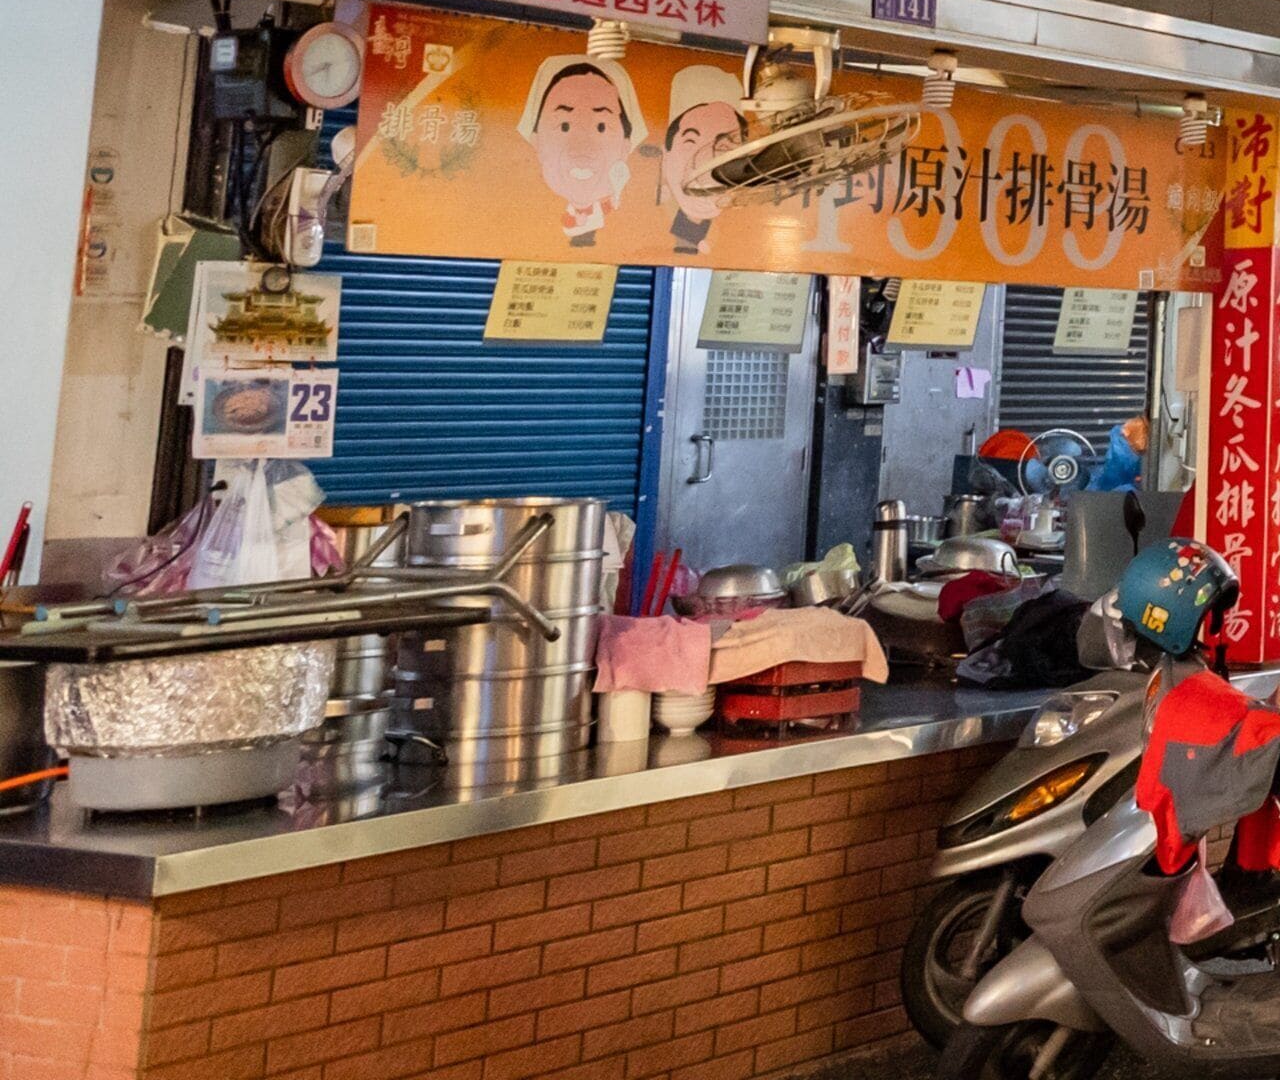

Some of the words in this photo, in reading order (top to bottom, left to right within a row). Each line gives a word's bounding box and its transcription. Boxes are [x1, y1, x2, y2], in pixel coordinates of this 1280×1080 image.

[377, 101, 483, 148] 排骨湯
[1225, 113, 1274, 235] 沛對
[290, 383, 333, 422] 23
